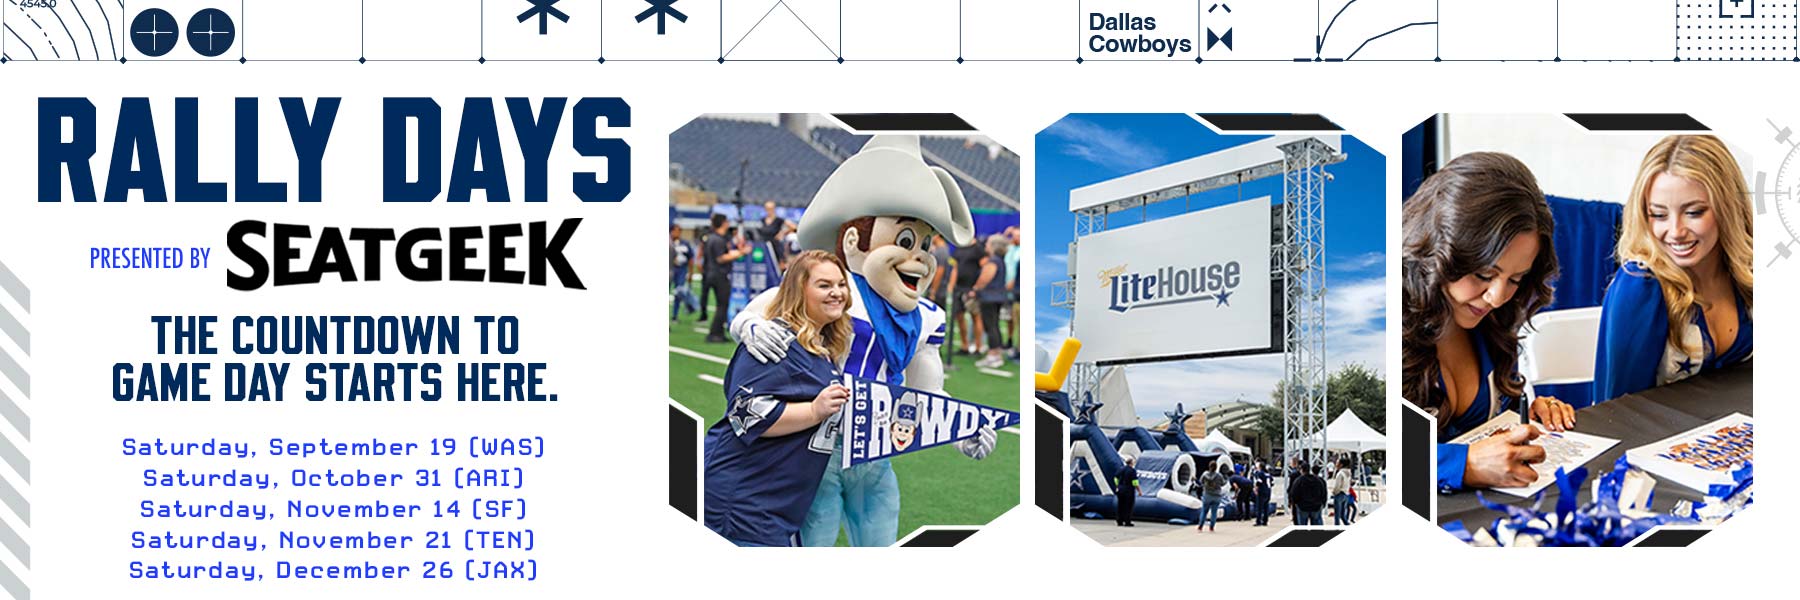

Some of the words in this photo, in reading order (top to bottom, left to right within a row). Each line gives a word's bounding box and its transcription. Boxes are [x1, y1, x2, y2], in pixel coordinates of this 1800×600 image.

[1108, 261, 1240, 313] LiteHouse
[855, 381, 867, 411] GET
[853, 415, 867, 459] LET'S
